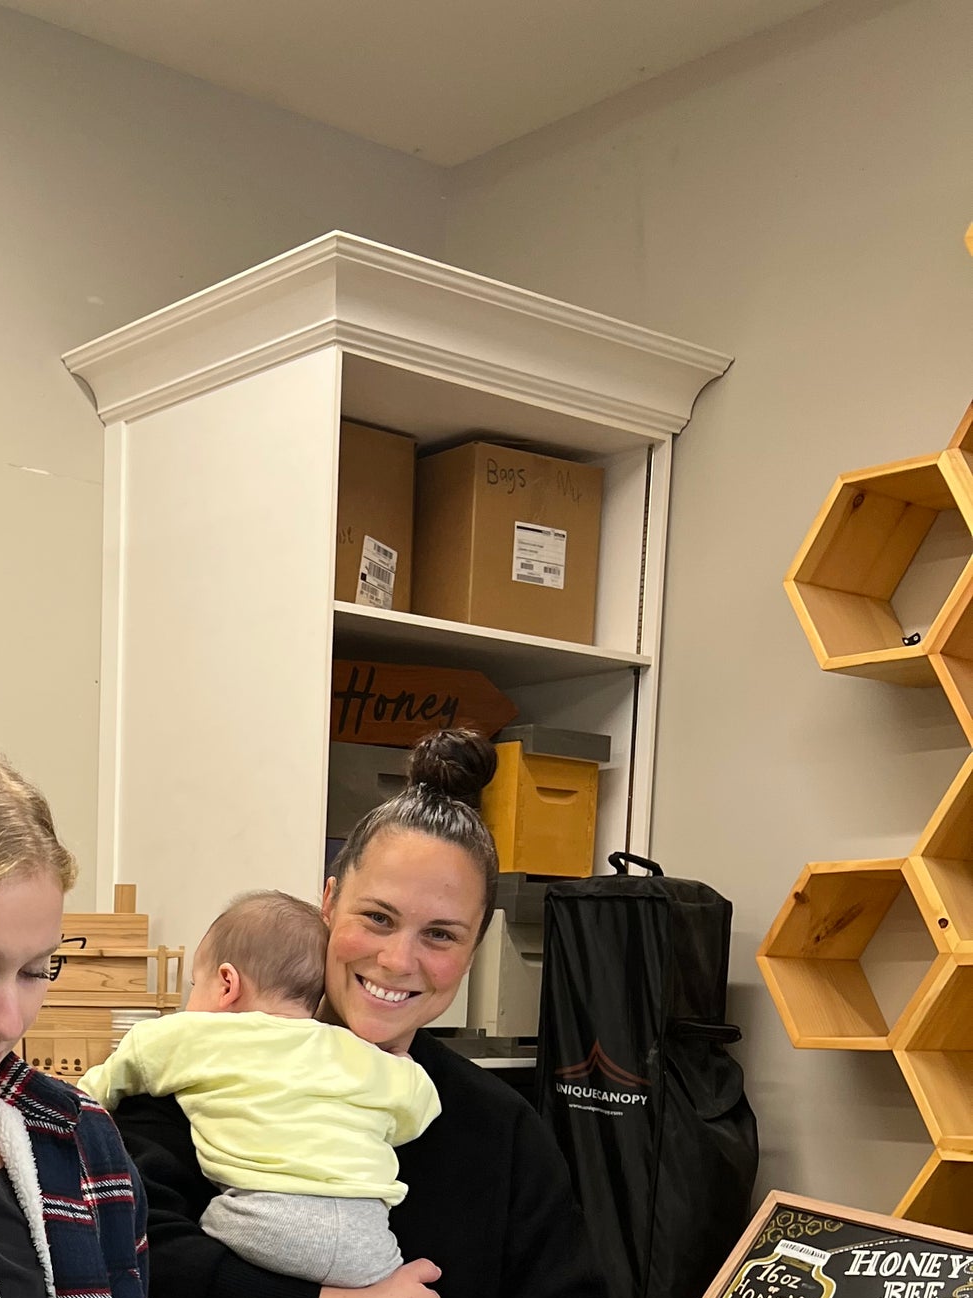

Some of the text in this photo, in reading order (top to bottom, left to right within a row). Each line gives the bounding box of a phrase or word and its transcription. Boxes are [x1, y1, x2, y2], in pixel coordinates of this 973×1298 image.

[486, 458, 527, 494] Bags
[334, 666, 459, 735] Honey
[556, 1082, 648, 1106] UNIQUECANOPY
[844, 1250, 973, 1278] HONEY
